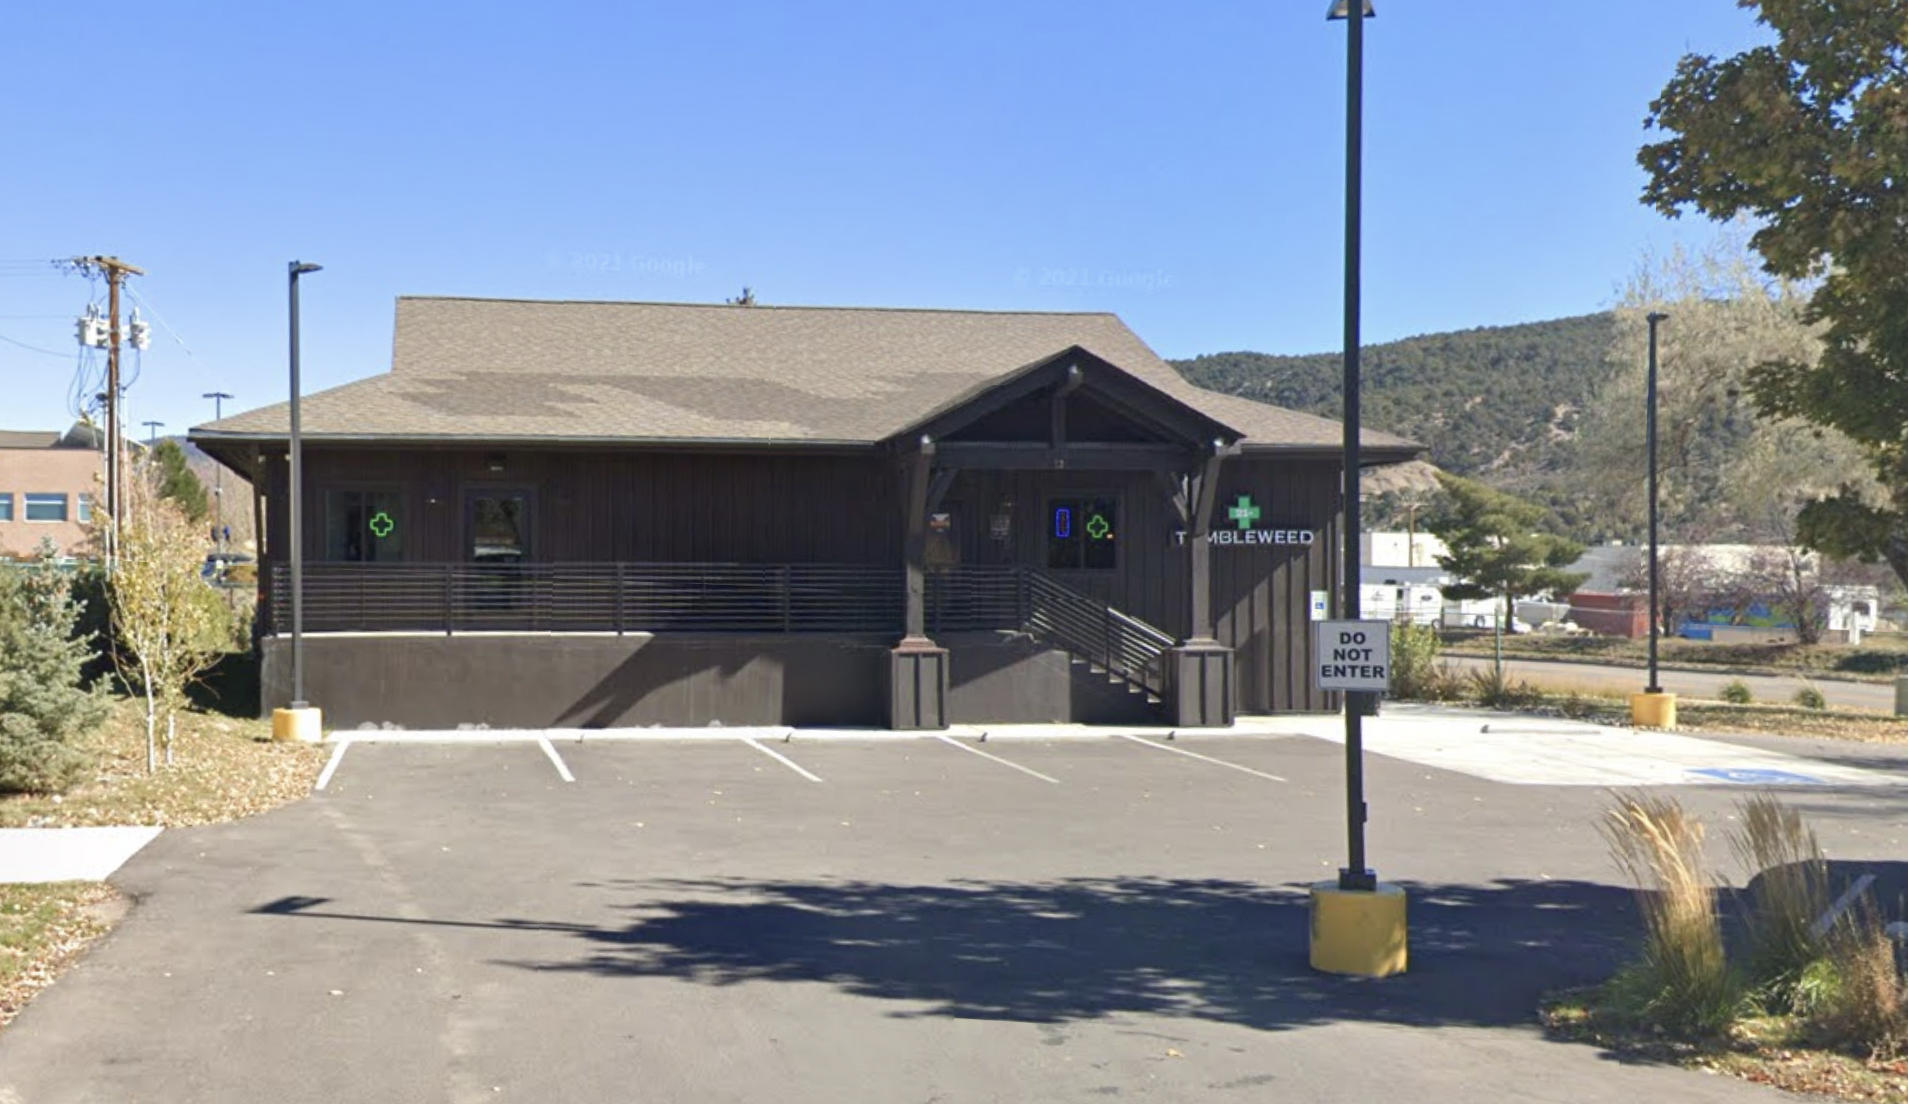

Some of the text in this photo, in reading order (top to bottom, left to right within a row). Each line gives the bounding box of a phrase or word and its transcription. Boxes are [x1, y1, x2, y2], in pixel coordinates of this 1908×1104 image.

[1175, 530, 1314, 545] TMBLEWEED
[1339, 632, 1366, 644] DO
[1333, 649, 1373, 661] NOT
[1321, 665, 1385, 678] ENTER
